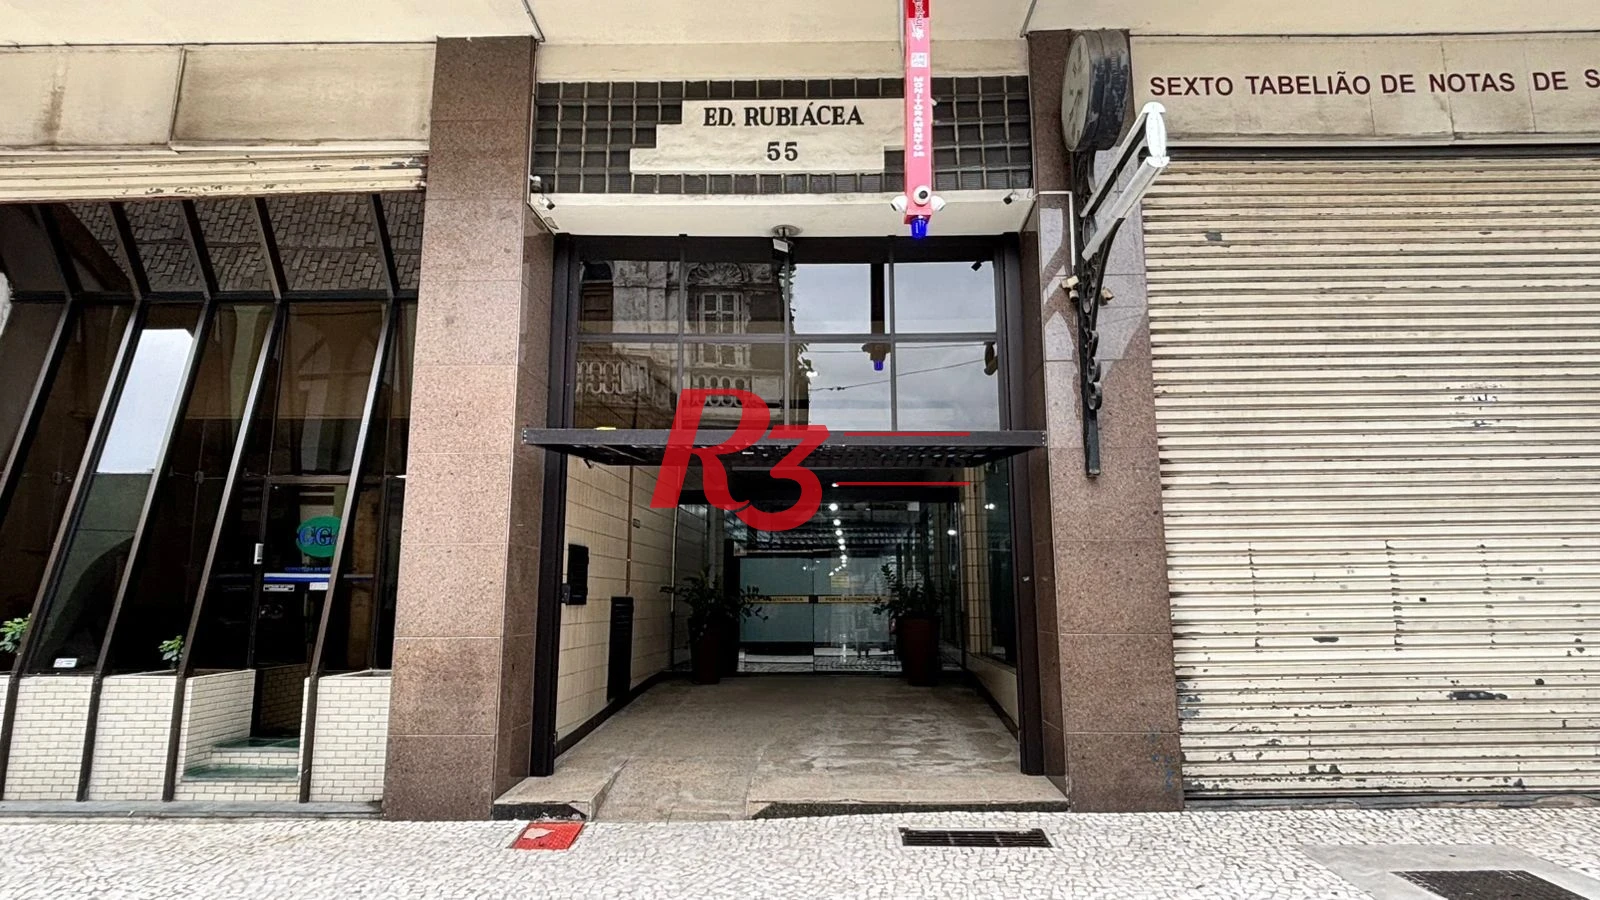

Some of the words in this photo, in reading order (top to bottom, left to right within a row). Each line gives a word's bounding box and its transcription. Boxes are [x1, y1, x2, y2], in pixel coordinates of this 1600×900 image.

[1150, 76, 1234, 96] SEXTO
[1244, 71, 1371, 95] TABELIÃO
[1380, 74, 1416, 94] DE
[1428, 72, 1516, 93] NOTAS
[1532, 71, 1569, 91] DE
[703, 107, 736, 127] ED.
[743, 102, 865, 127] RUBIÁCEA
[767, 141, 798, 162] 55
